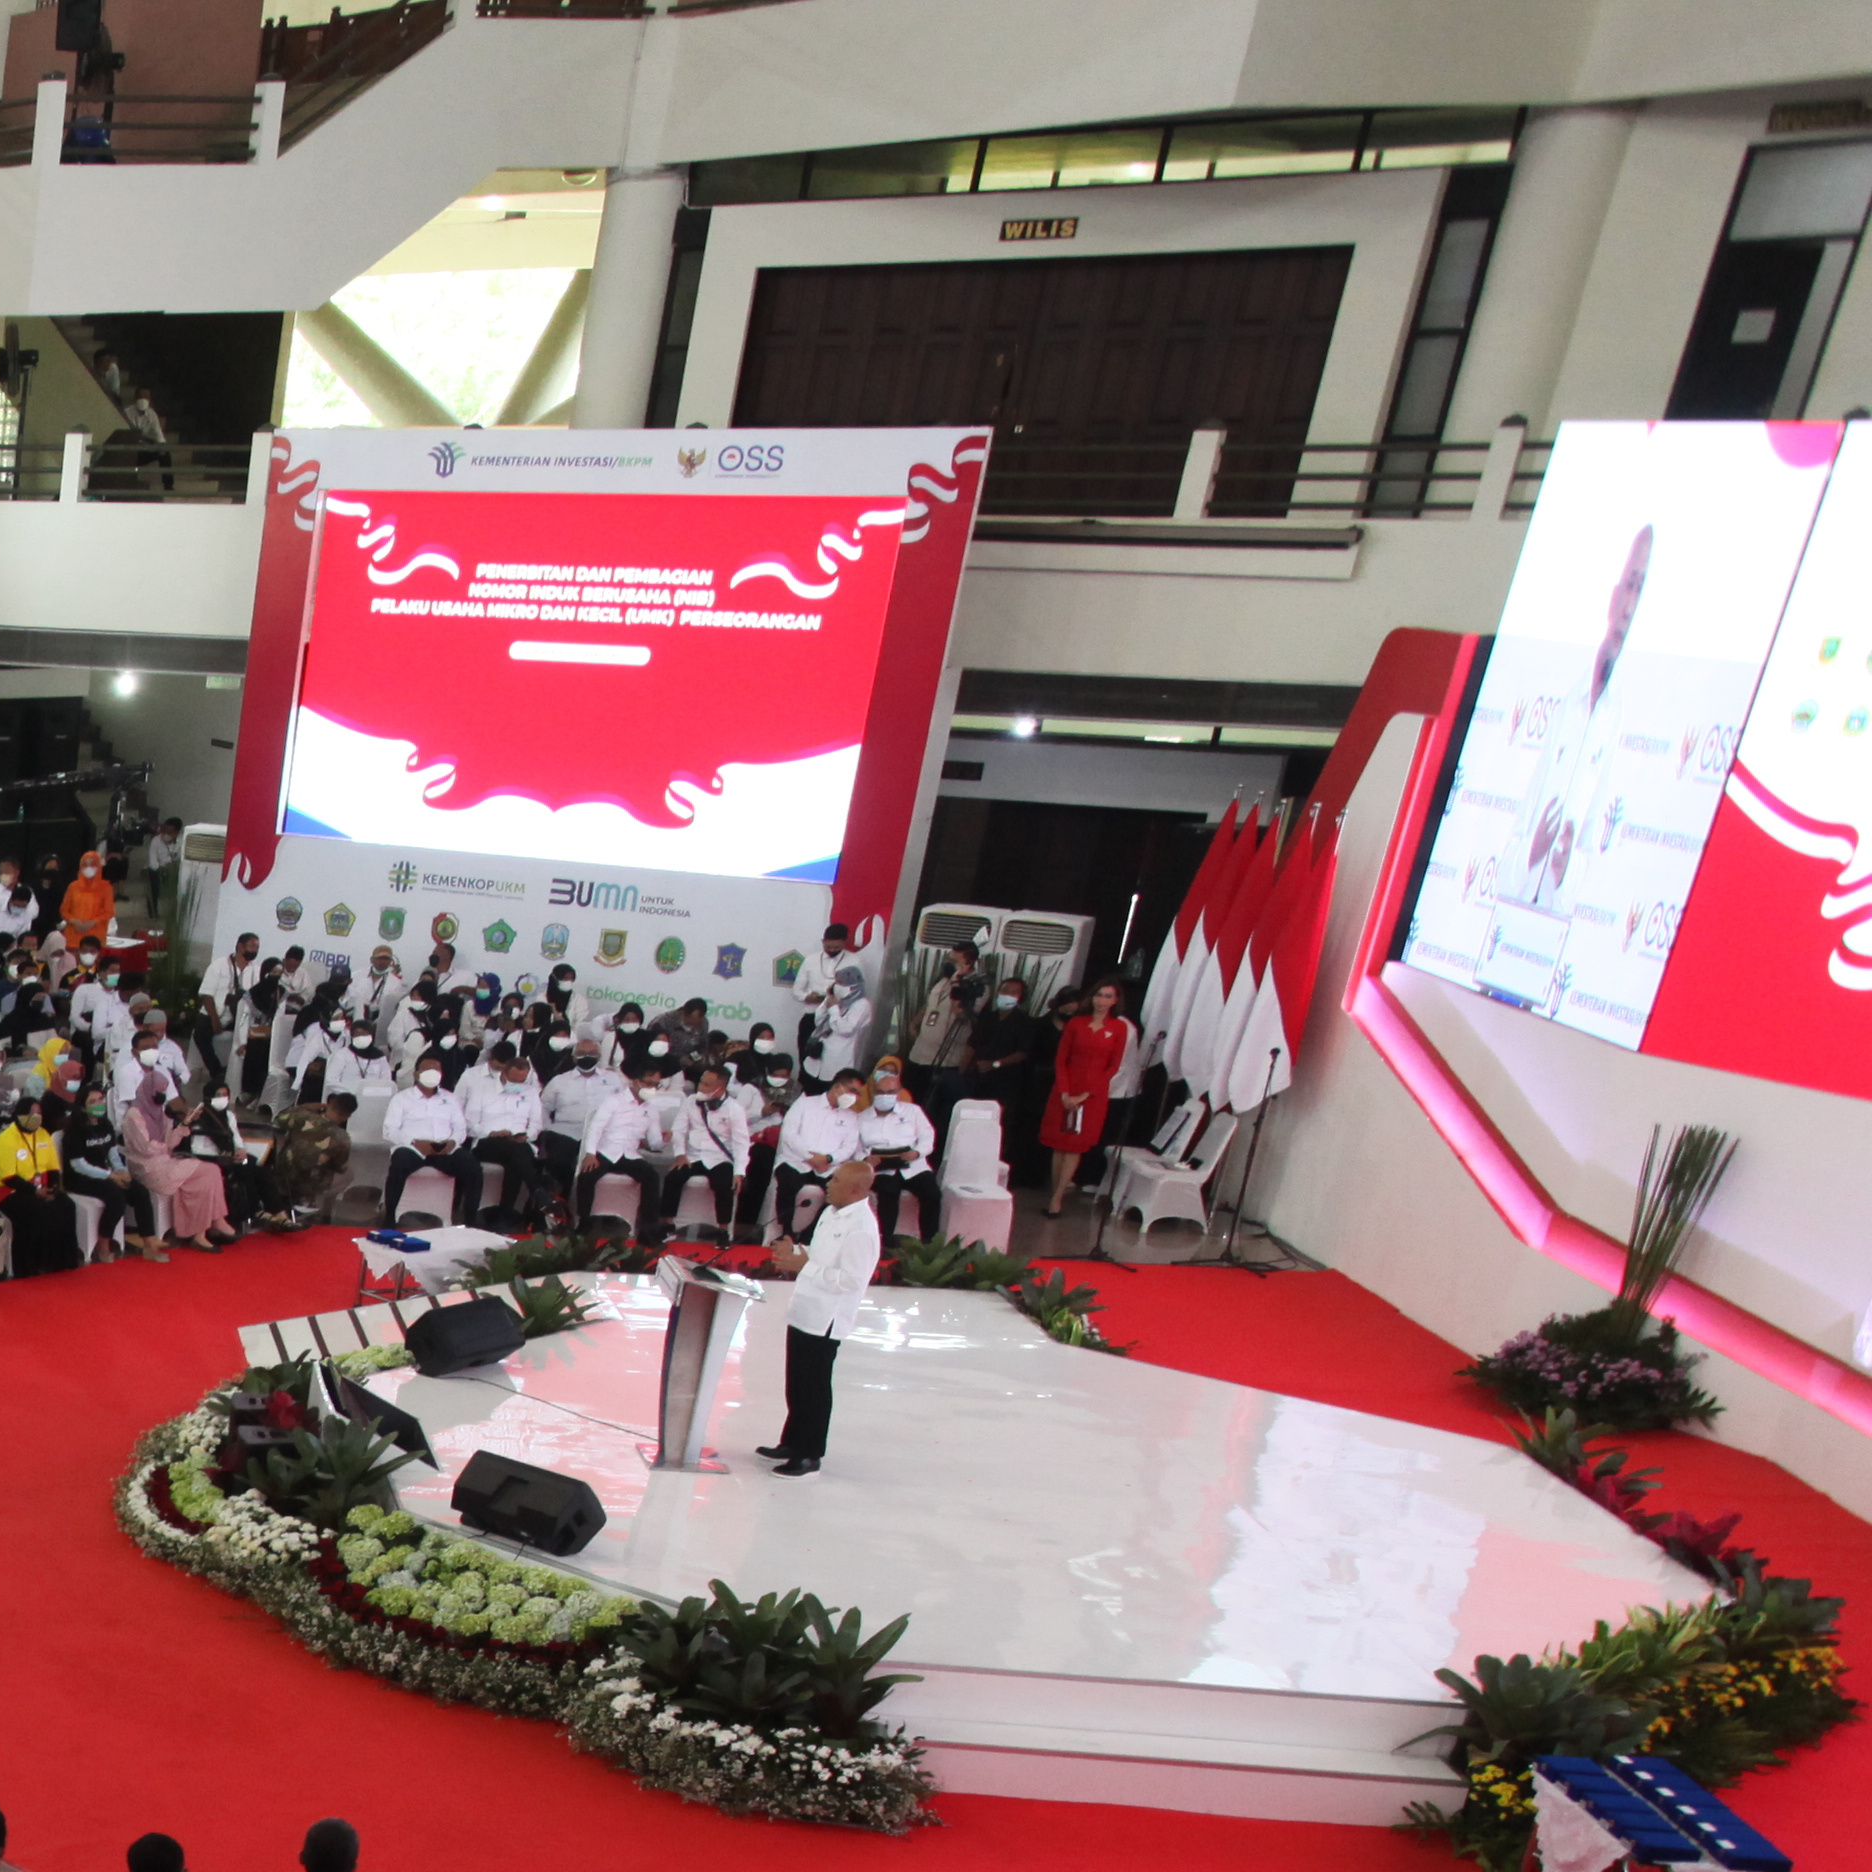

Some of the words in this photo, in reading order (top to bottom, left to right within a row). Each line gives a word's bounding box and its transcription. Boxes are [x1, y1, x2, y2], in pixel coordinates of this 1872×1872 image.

[1004, 219, 1076, 240] WILIS
[470, 455, 551, 467] KEMENTERIAN
[553, 455, 653, 468] INVESTASI/BKPM
[717, 444, 785, 472] OSS
[475, 562, 575, 582] PENERBITAN
[575, 565, 613, 582] DAN
[613, 567, 714, 586] PEMBAGIAN
[467, 582, 529, 600] NOMOR
[529, 584, 581, 601] INDUK
[581, 586, 672, 606] BERUSAHA
[673, 589, 716, 608] (NIB)
[370, 597, 431, 615] PELAKU
[431, 599, 486, 618] USAHA
[486, 602, 539, 620] MIKRO
[539, 604, 577, 622] DAN
[577, 606, 624, 624] KECIL
[624, 607, 676, 627] (UMK)
[678, 609, 823, 631] PERSEORANGAN
[422, 872, 526, 894] KEMENKOPUKM
[640, 895, 675, 906] UNTUK
[638, 905, 692, 918] INDONESIA
[586, 984, 678, 1010] tokopedia
